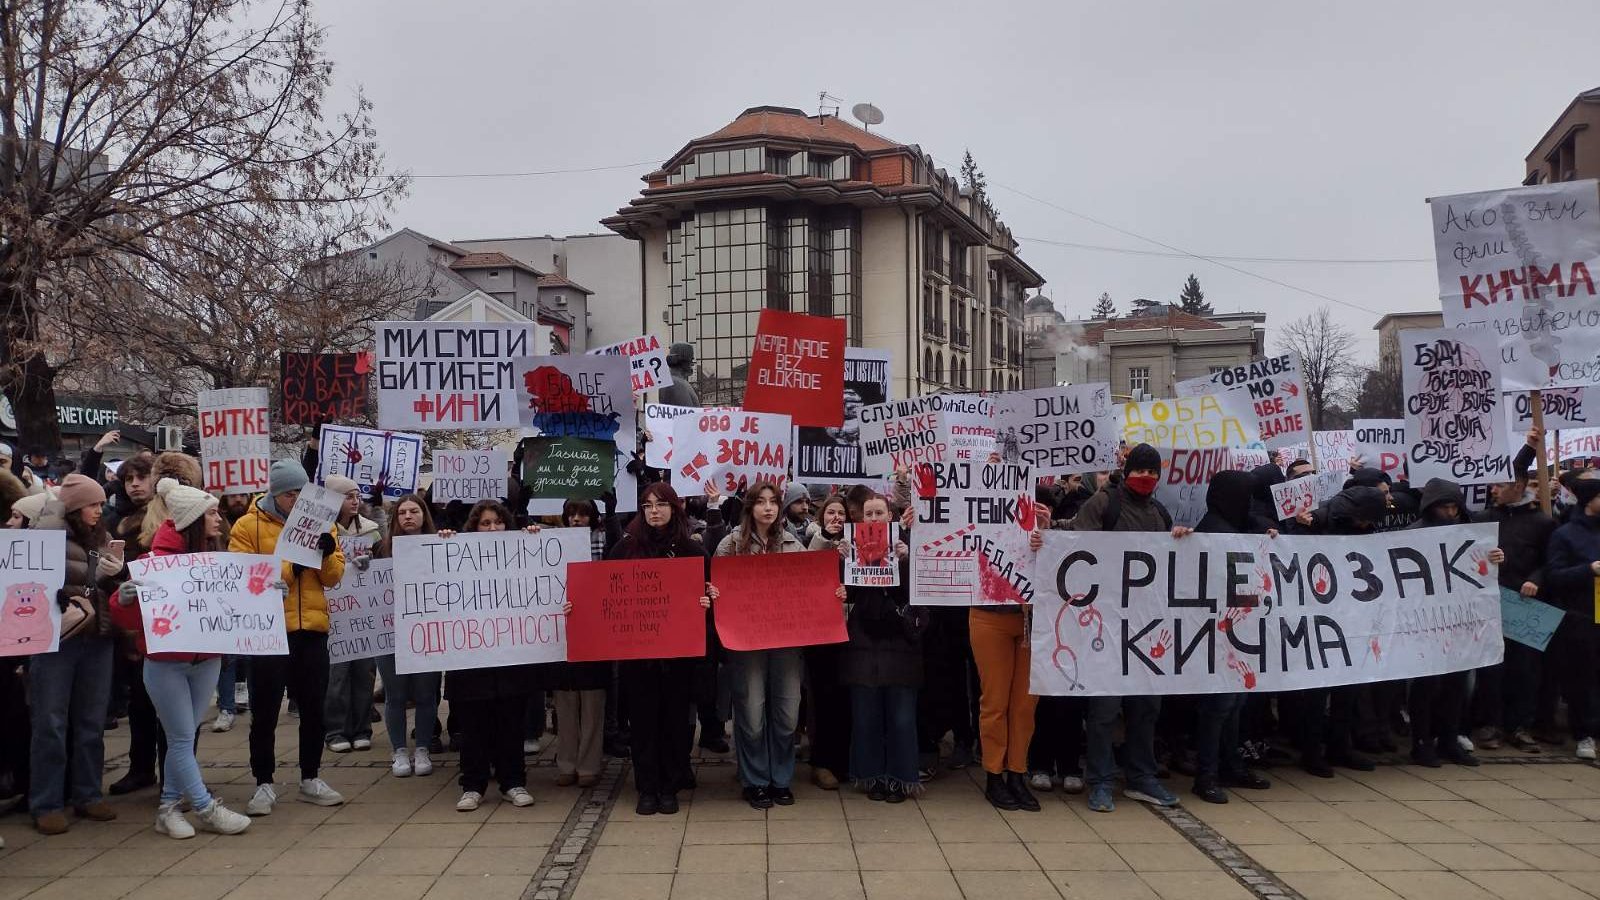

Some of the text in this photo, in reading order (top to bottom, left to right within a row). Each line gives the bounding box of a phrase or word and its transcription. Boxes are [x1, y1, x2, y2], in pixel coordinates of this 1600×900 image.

[1459, 261, 1597, 309] КИЧМА
[756, 334, 830, 359] NEMA NADE
[286, 353, 351, 378] РУКЕ
[775, 353, 803, 371] BEZ
[284, 378, 307, 399] СУ
[316, 379, 366, 400] ВАМ
[758, 368, 822, 390] BLOKADE
[413, 393, 501, 422] ФИНИ
[860, 395, 942, 423] СЛУШАМО
[1033, 394, 1080, 418] DUM
[1408, 391, 1450, 415] СВОЈЕ
[201, 408, 269, 438] БИТКЕ
[698, 415, 759, 434] ОВО ЈЕ
[883, 413, 937, 437] БАЈКЕ
[1019, 419, 1095, 444] SPIRO
[1430, 417, 1443, 439] И
[716, 438, 784, 469] ЗЕМЉА
[865, 429, 935, 456] ЖИВИМО
[1411, 440, 1461, 463] СВОЈЕ
[438, 455, 490, 474] ПМФ УЗ
[802, 445, 858, 474] U IME SVIH
[890, 443, 947, 471] ХОРОР
[1021, 444, 1096, 468] SPERO
[1452, 454, 1513, 479] СВЕСТИ
[206, 458, 268, 492] ДЕЦУ
[725, 471, 748, 492] ЗА
[982, 463, 1029, 491] ФИЛМ
[434, 478, 502, 498] ПРОСВЕТАРЕ
[918, 496, 950, 524] ЈЕ
[139, 554, 218, 577] УБИЈАТЕ
[421, 537, 562, 573] ТРАЖИМО
[189, 563, 243, 580] СРБИЈУ
[352, 572, 367, 588] ЈЕ
[632, 565, 660, 580] have
[962, 535, 1035, 603] ГЛЕДАТИ
[141, 586, 168, 602] БЕЗ
[181, 580, 238, 595] ОТИСКА
[402, 575, 567, 619] ДЕФИНИЦИЈУ
[609, 580, 662, 593] the best
[188, 598, 208, 613] НА
[199, 614, 275, 633] ПИШТОЉУ
[350, 615, 376, 633] РЕКЕ
[410, 613, 564, 656] ОДГОВОРНОСТ
[612, 620, 660, 636] can buy
[1120, 613, 1353, 677] КИЧМА
